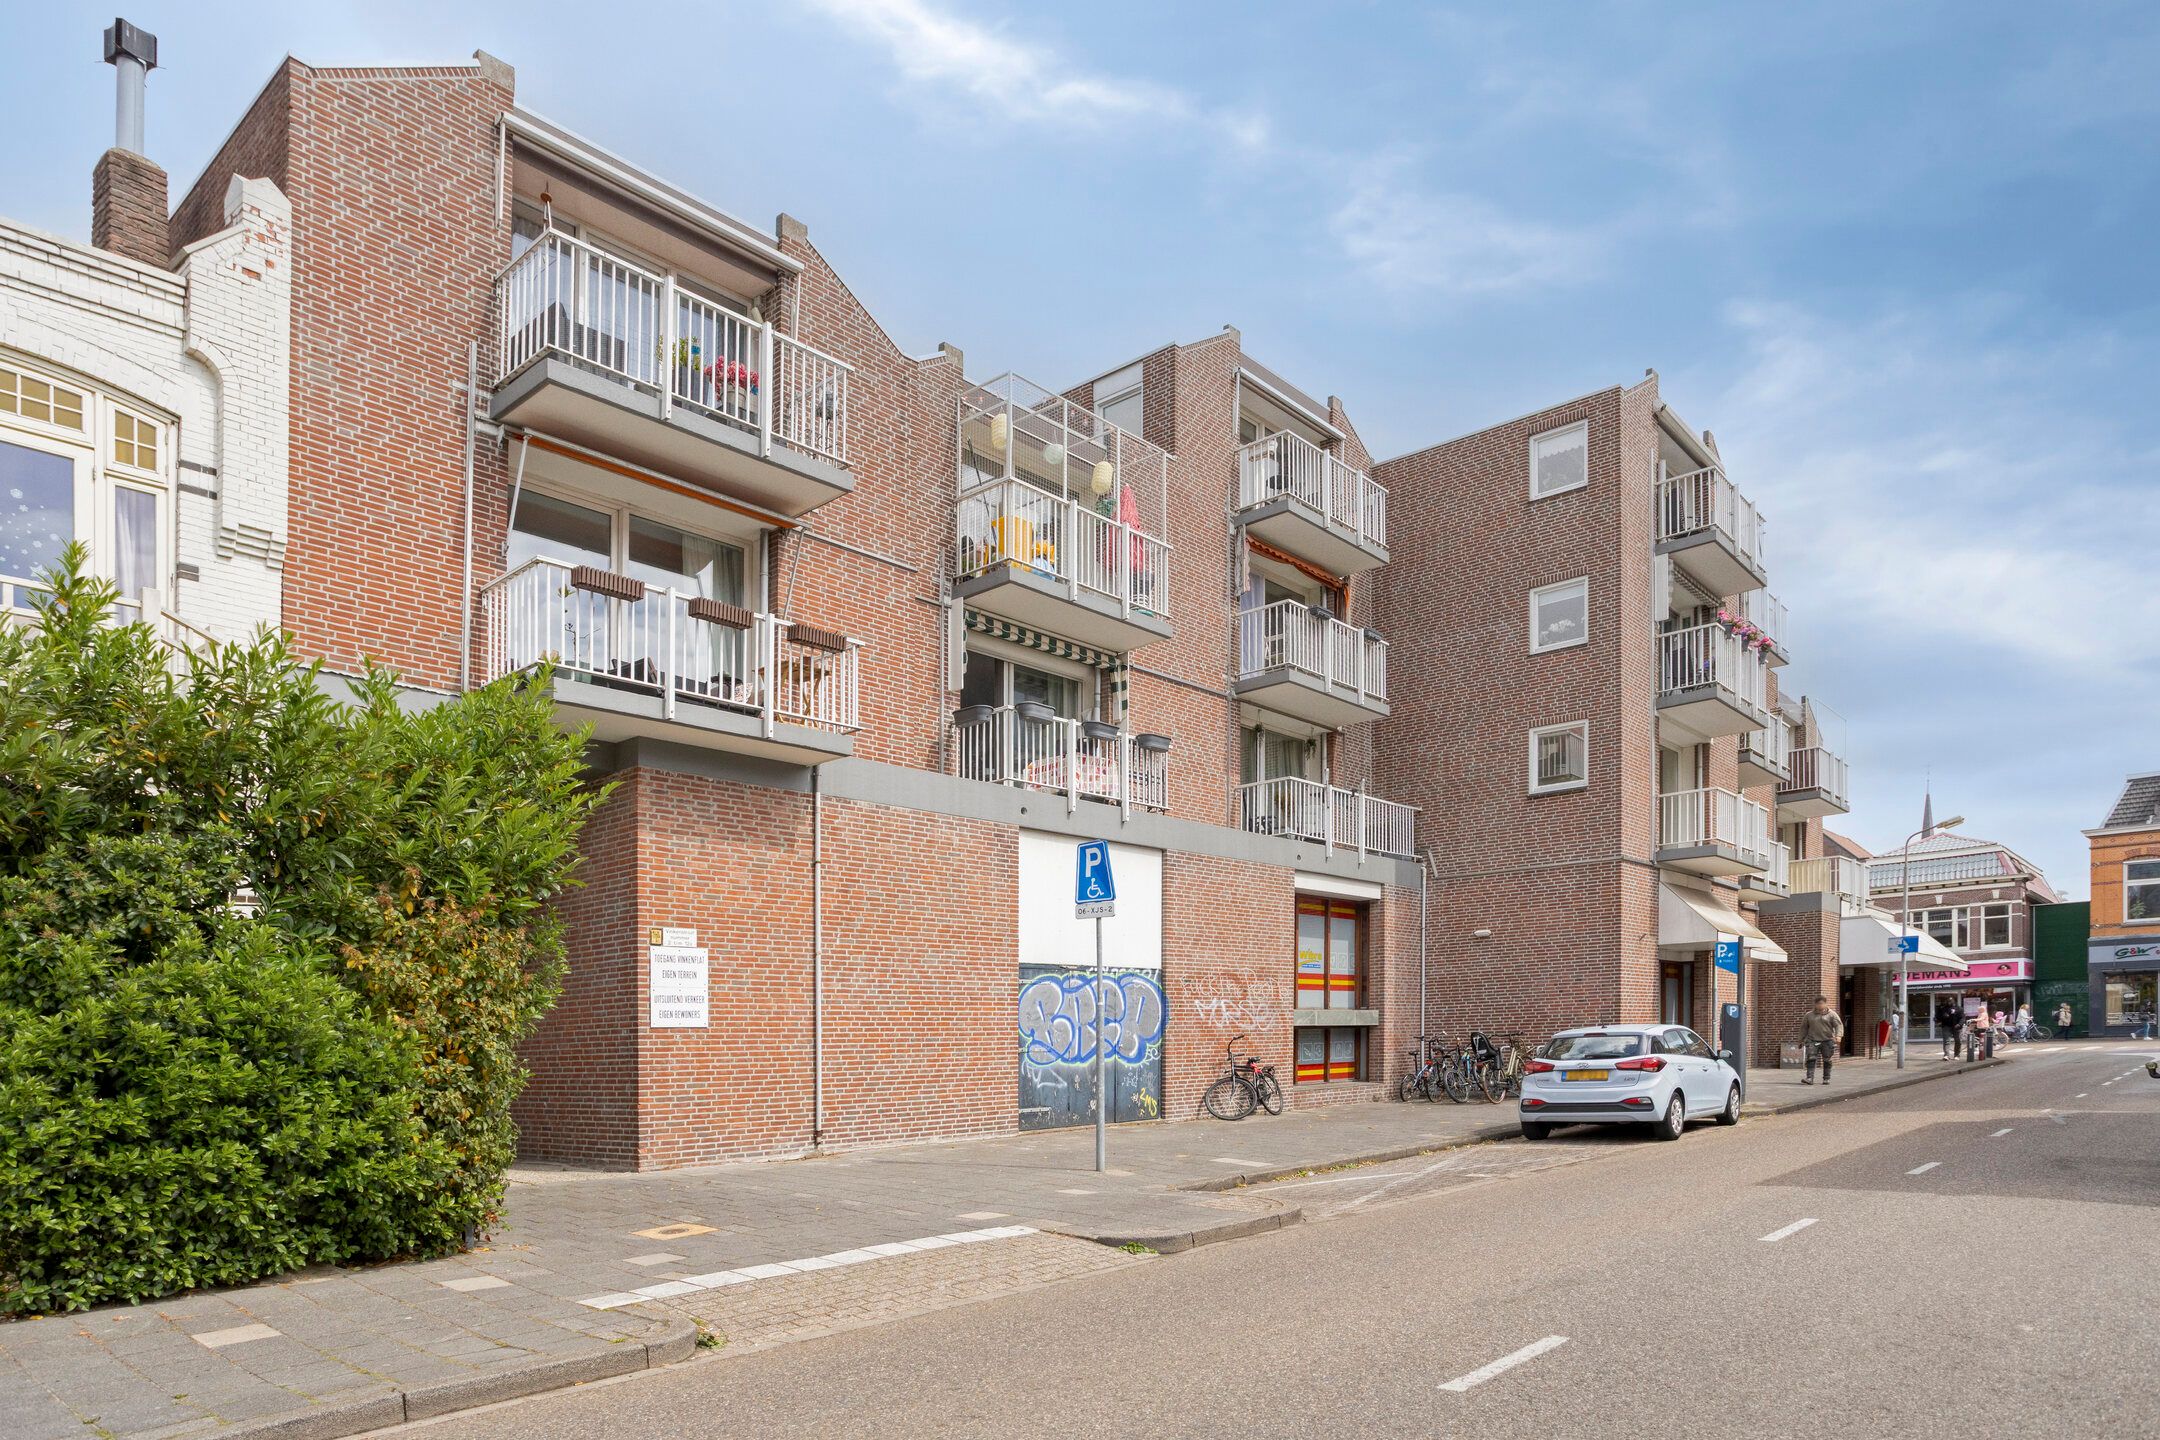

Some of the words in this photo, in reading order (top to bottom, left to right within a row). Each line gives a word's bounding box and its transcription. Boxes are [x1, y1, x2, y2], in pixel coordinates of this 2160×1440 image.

[1085, 847, 1102, 878] P
[1077, 905, 1113, 915] 06-XJS-2
[1717, 944, 1728, 958] P
[654, 954, 676, 964] TOEGANG
[677, 955, 705, 965] VINKENFLAT
[662, 969, 677, 979] EIGEN
[677, 970, 698, 980] TERREIN
[654, 994, 684, 1004] UITSLUITEND
[684, 995, 705, 1004] VERKEER
[659, 1010, 674, 1019] EIGEN
[674, 1010, 701, 1019] BEWONERS
[1729, 1006, 1738, 1017] P
